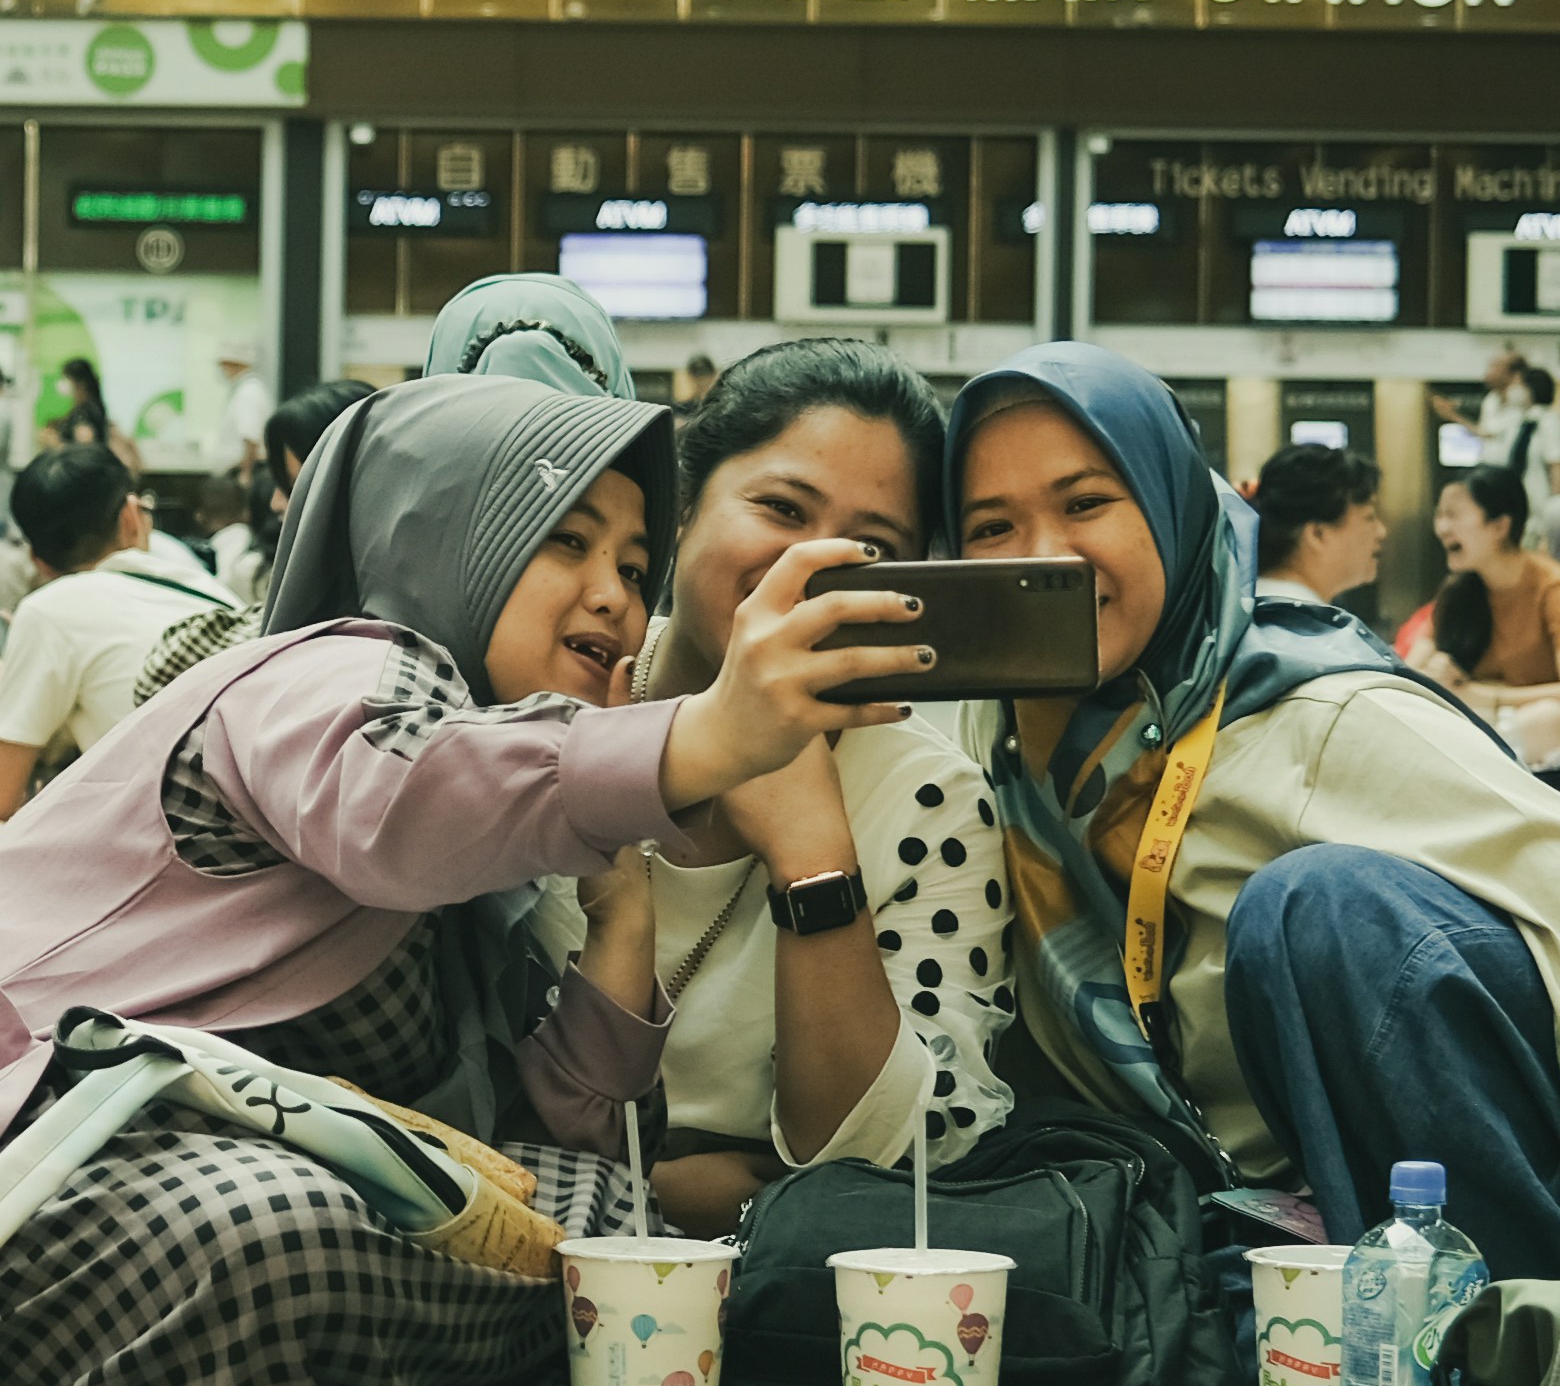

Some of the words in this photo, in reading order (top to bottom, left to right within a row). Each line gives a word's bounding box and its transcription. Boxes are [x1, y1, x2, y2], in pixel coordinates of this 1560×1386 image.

[1151, 158, 1281, 198] Tickets
[1299, 164, 1438, 204] Vending
[119, 296, 186, 325] TP
